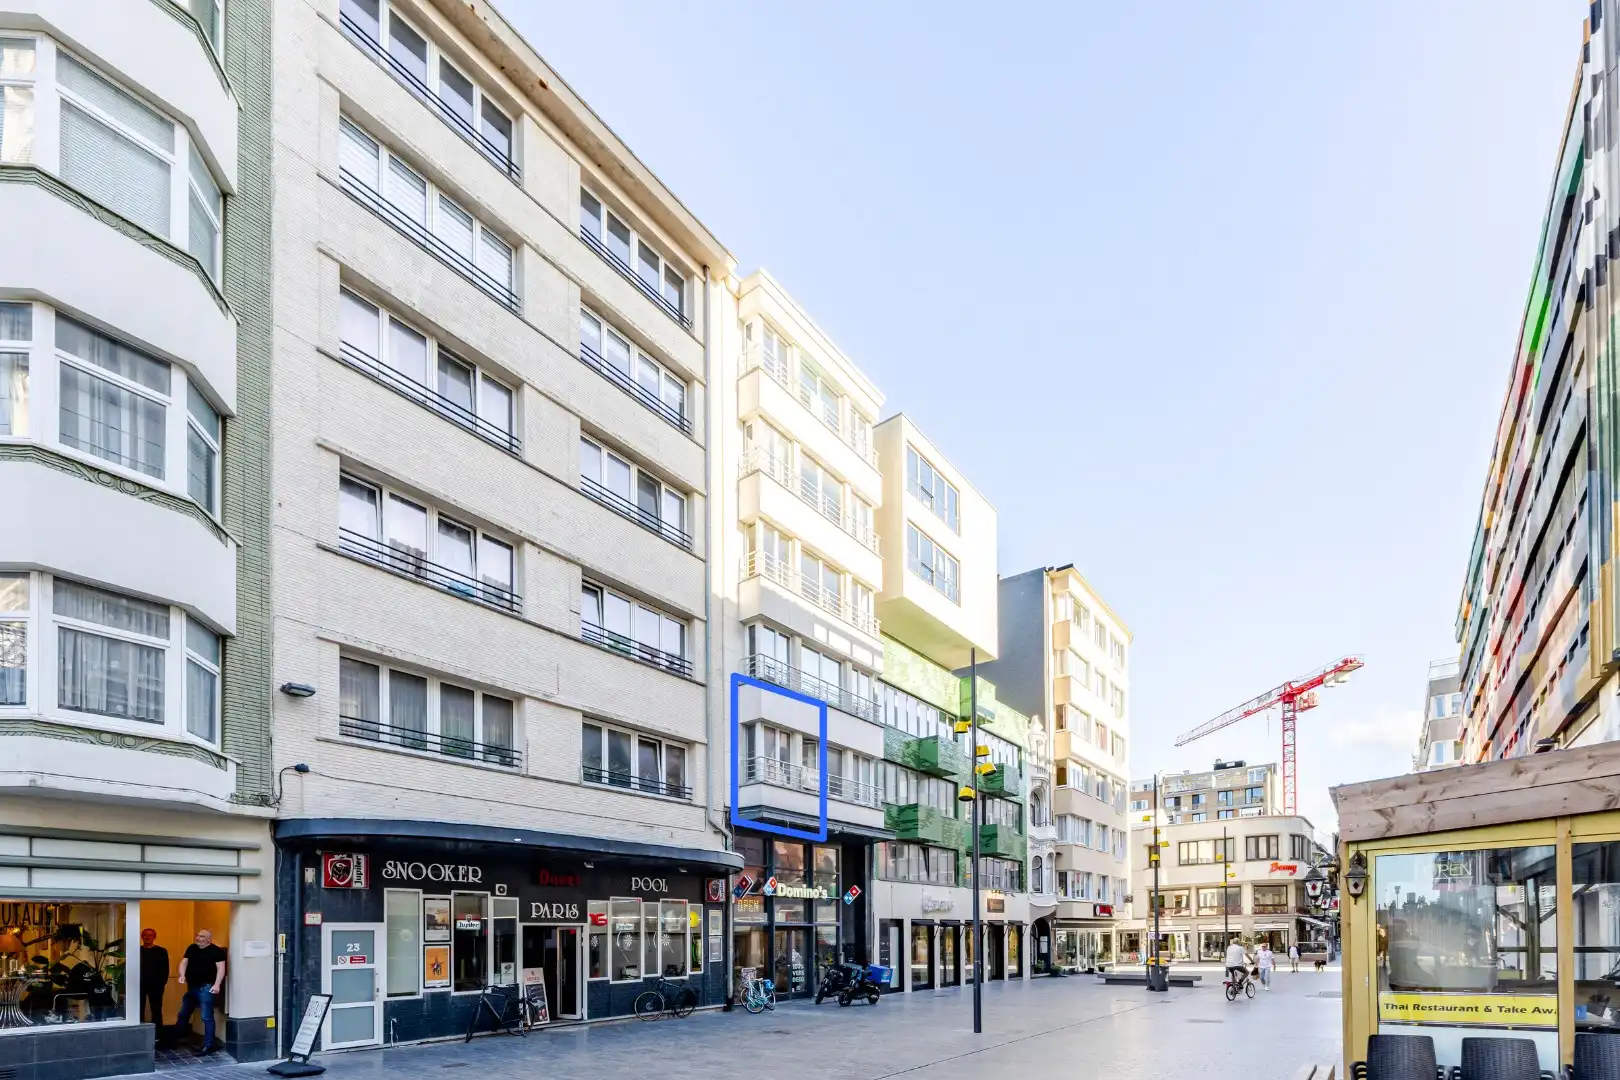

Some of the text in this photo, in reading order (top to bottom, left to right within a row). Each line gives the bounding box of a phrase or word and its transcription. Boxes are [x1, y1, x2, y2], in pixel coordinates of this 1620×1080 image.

[354, 855, 363, 886] Jupiler
[382, 860, 482, 884] SNOOKER
[631, 877, 668, 892] POOL
[777, 883, 828, 899] Domino's
[531, 902, 579, 919] PARIS
[346, 943, 360, 952] 23
[1384, 1002, 1409, 1011] Thai
[1413, 1003, 1479, 1012] Restaurant
[1484, 1005, 1492, 1013] &
[1497, 1005, 1527, 1014] Take
